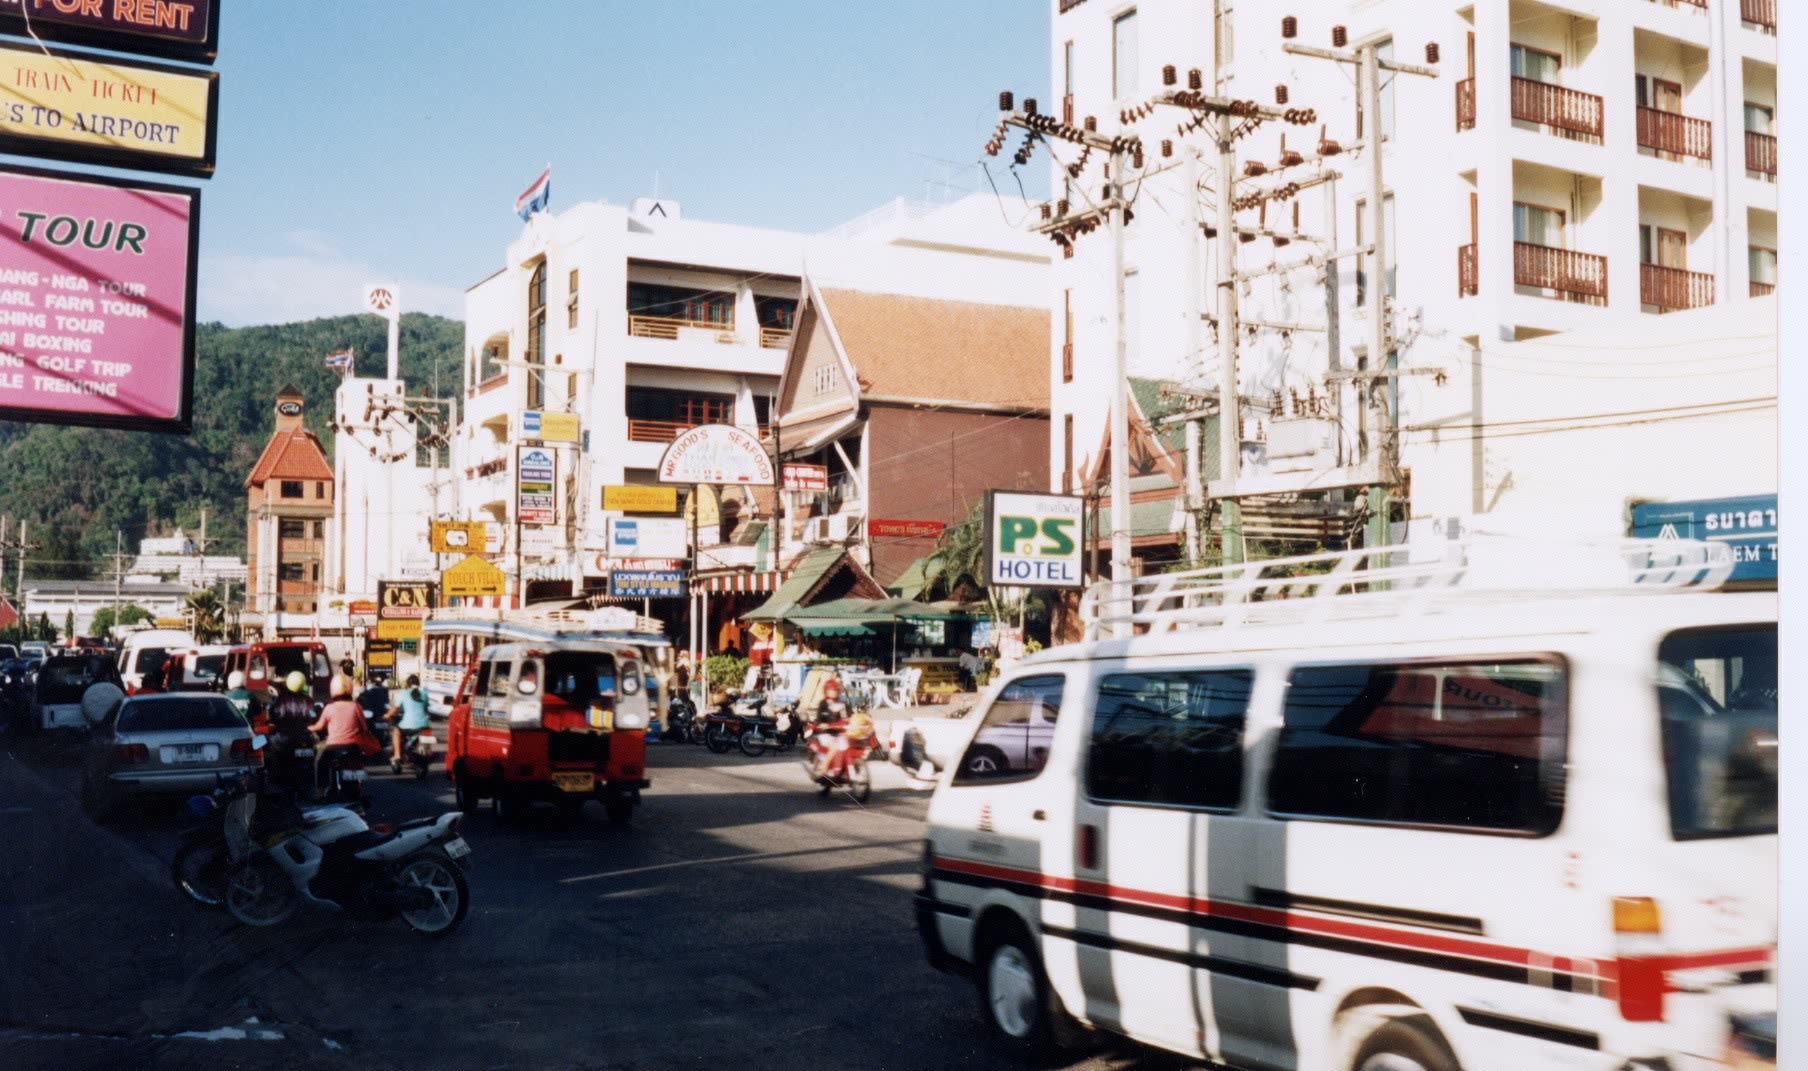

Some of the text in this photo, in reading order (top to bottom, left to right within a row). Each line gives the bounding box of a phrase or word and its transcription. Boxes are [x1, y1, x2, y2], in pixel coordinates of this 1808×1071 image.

[113, 0, 194, 30] RENT
[15, 67, 72, 93] TRAIN
[31, 105, 62, 128] TO
[72, 112, 180, 144] AIRPORT
[17, 211, 147, 254] TOUR
[98, 279, 146, 298] TOUR
[45, 293, 95, 313] FARM
[101, 300, 148, 319] TOUR
[55, 315, 105, 335] TOUR
[23, 332, 92, 354] BOXING
[36, 355, 86, 374] GOLF
[91, 360, 132, 379] TRIP
[32, 374, 118, 398] TREKKING
[999, 560, 1074, 580] HOTEL
